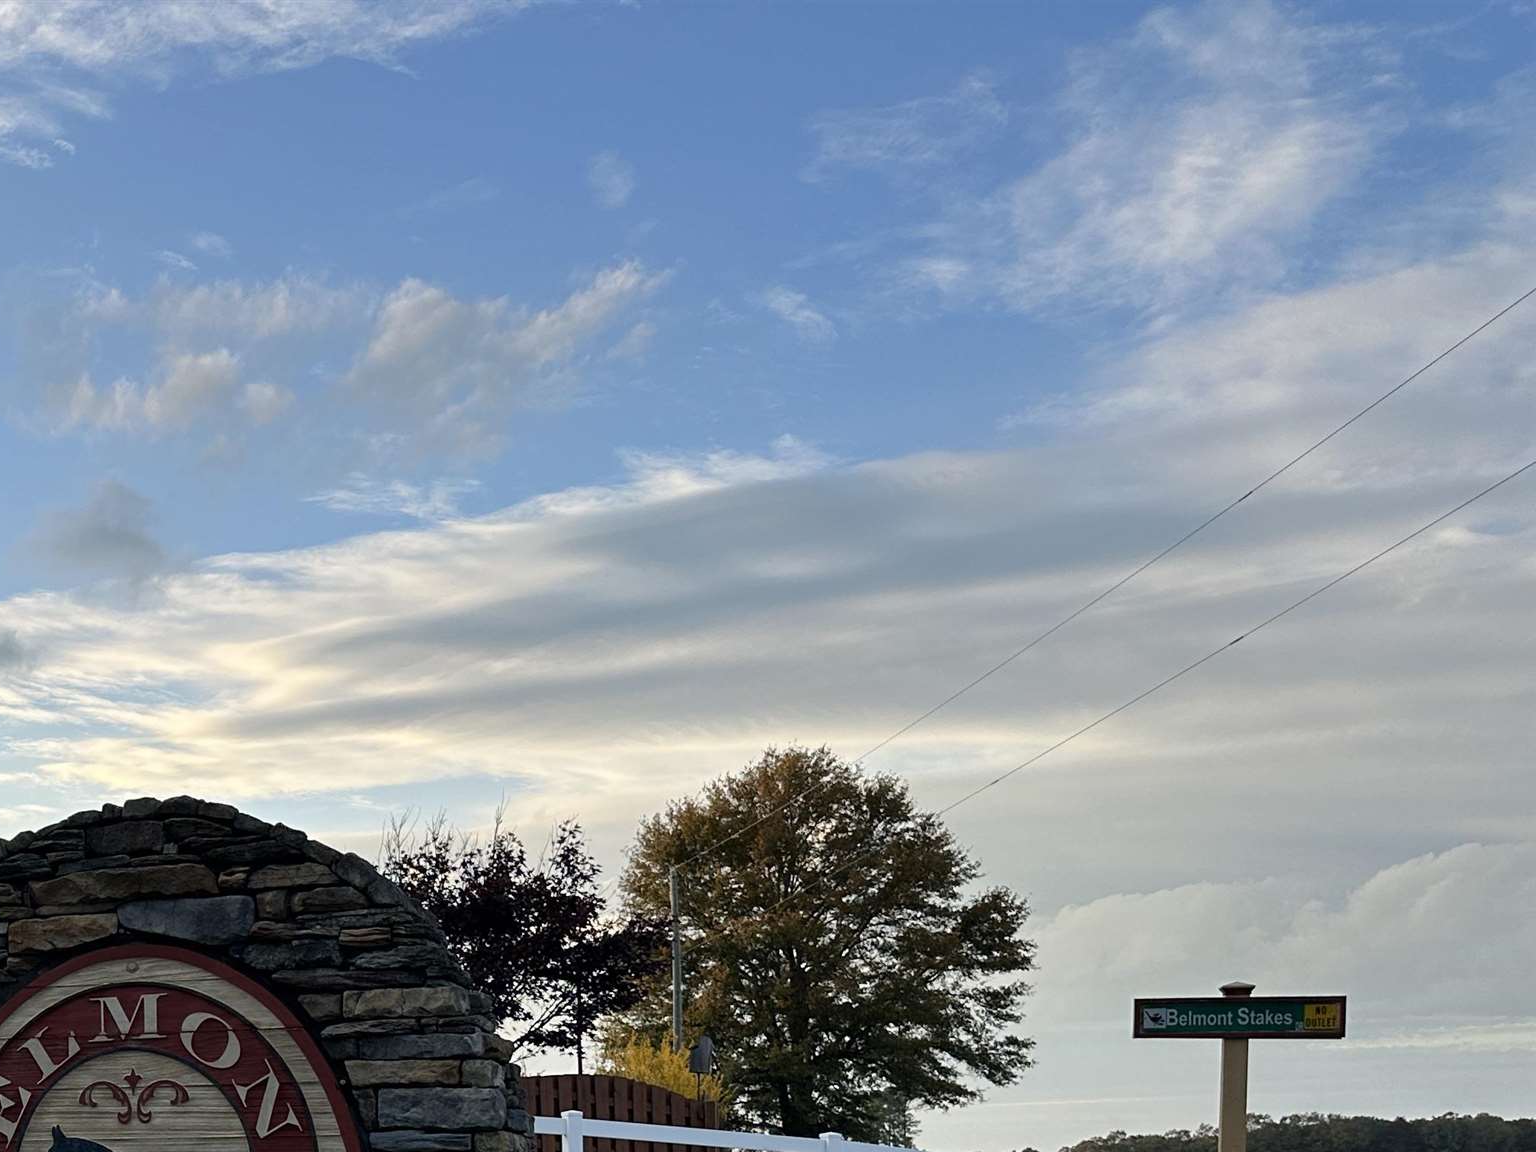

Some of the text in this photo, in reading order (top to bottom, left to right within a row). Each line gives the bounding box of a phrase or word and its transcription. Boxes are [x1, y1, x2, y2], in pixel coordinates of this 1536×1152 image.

[1315, 1005, 1327, 1015] NO
[1167, 1008, 1233, 1027] Belmont
[1237, 1007, 1293, 1025] Stakes
[1305, 1017, 1337, 1027] OUTLET
